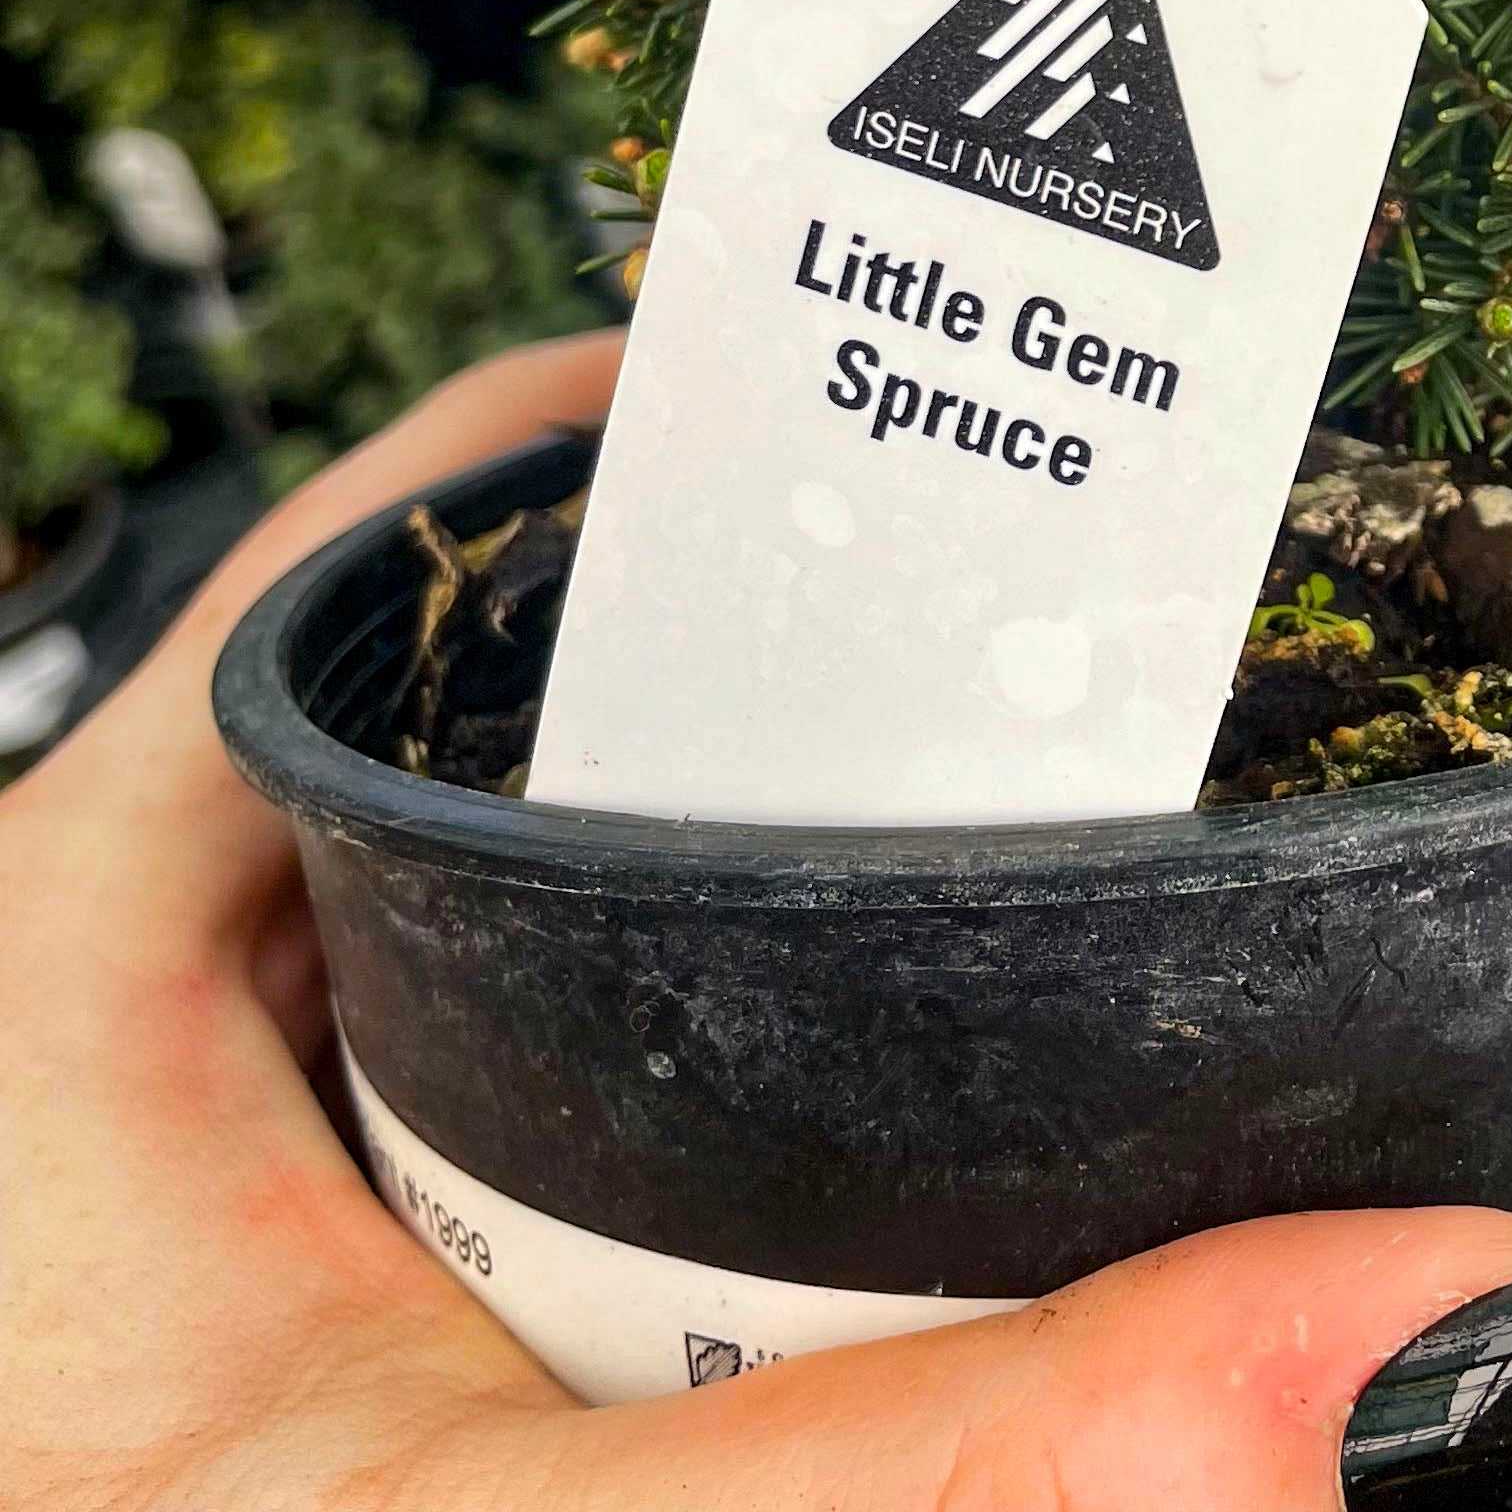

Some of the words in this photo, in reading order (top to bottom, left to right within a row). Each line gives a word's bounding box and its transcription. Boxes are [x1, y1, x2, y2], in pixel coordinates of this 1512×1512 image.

[853, 106, 966, 174] ISELI
[974, 146, 1202, 251] NURSERY
[794, 219, 985, 343] Little
[1011, 296, 1180, 412] Gem
[827, 339, 1092, 486] Spruce
[403, 1172, 493, 1278] #1999
